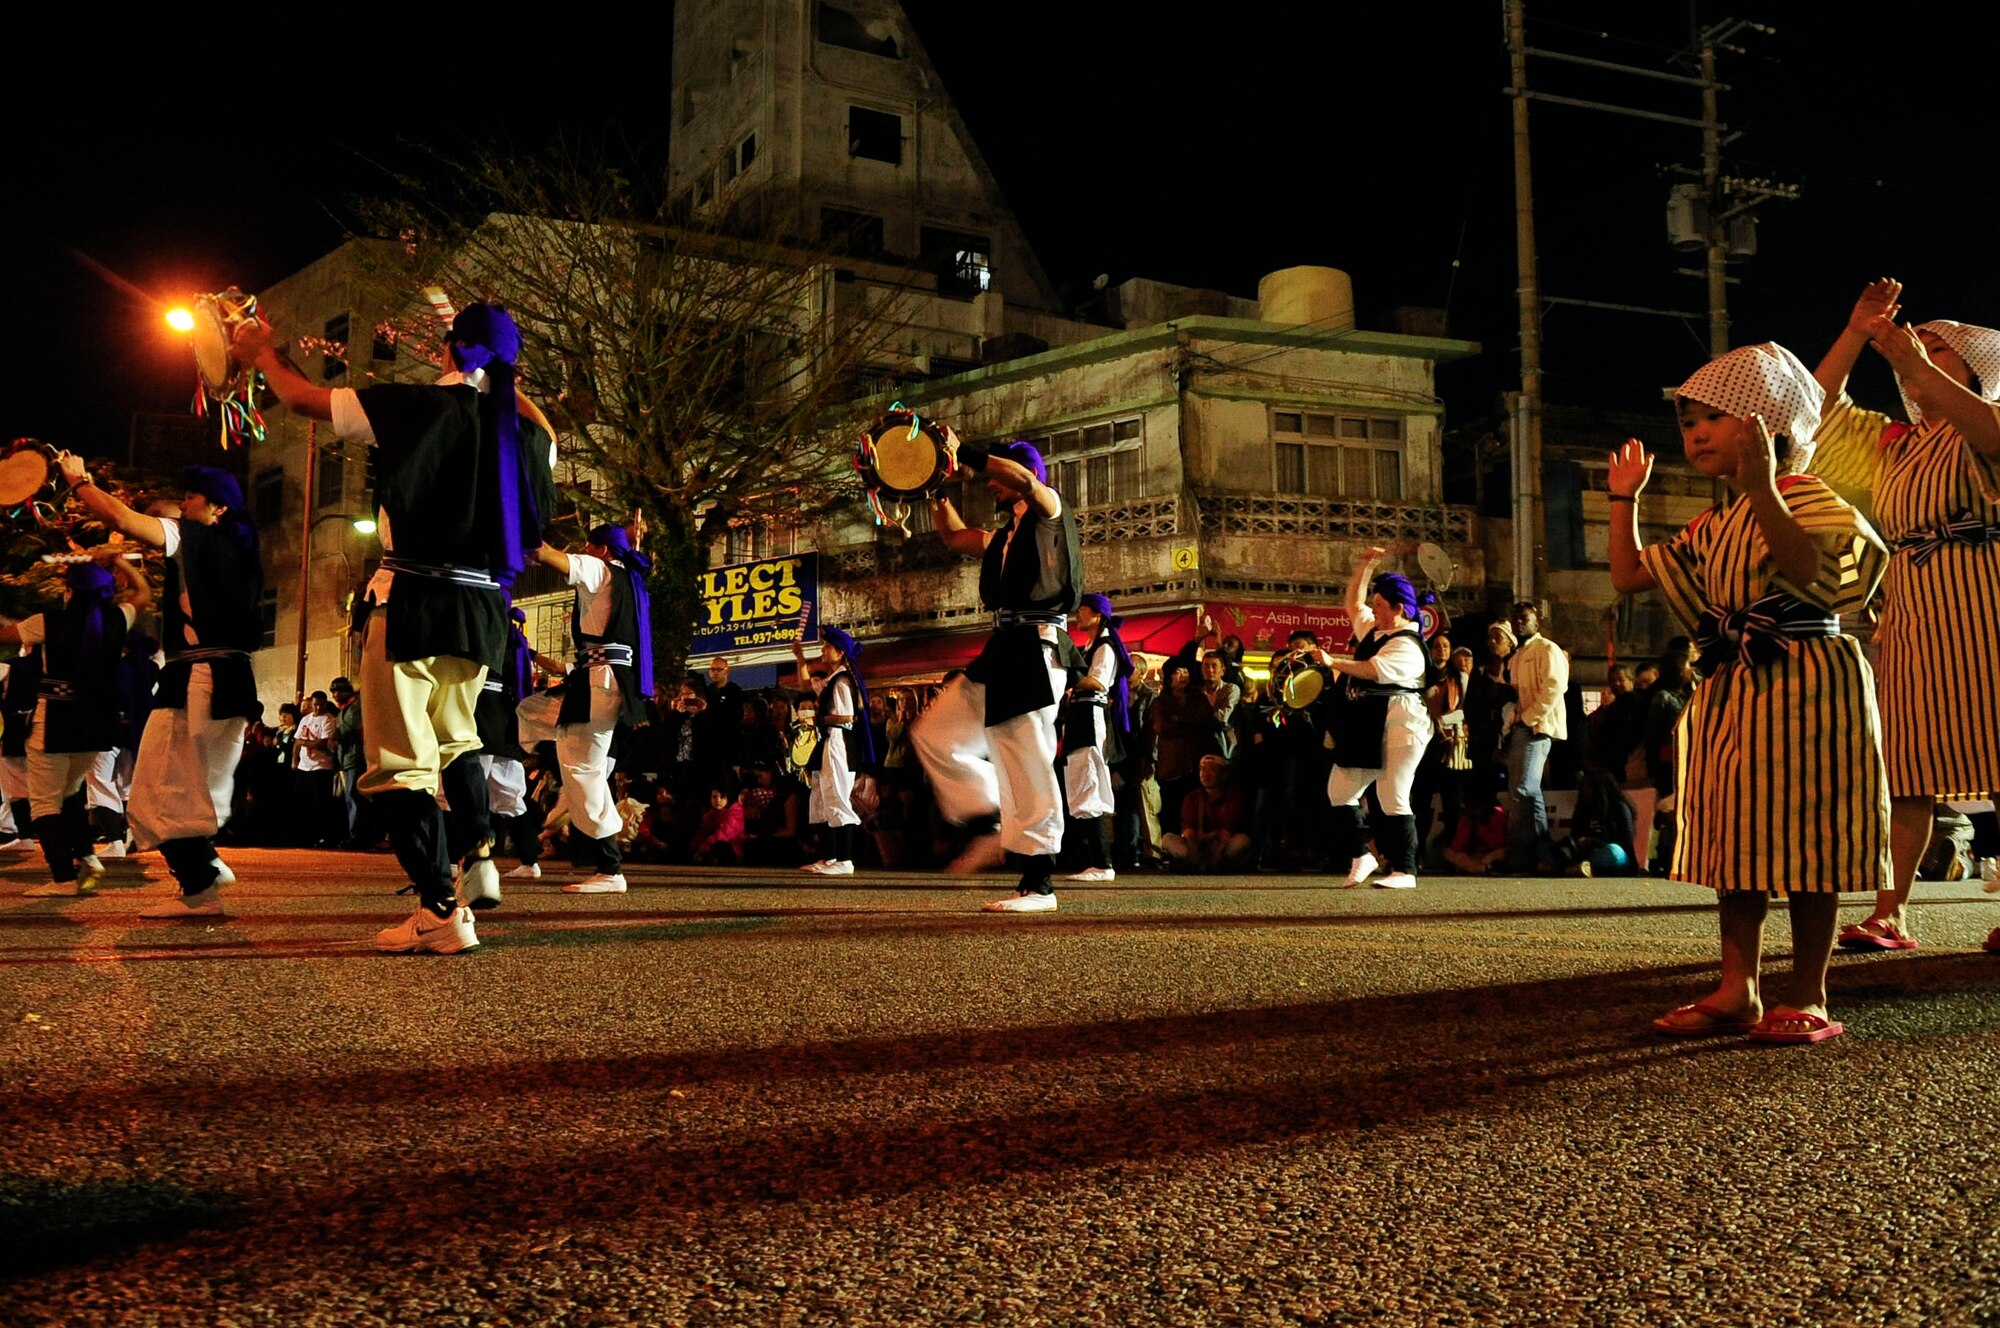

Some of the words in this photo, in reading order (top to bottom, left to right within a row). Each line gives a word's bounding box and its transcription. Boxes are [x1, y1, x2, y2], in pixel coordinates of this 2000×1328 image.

[699, 558, 802, 599] LECT
[702, 586, 803, 625] YLES
[1304, 612, 1350, 630] Imports
